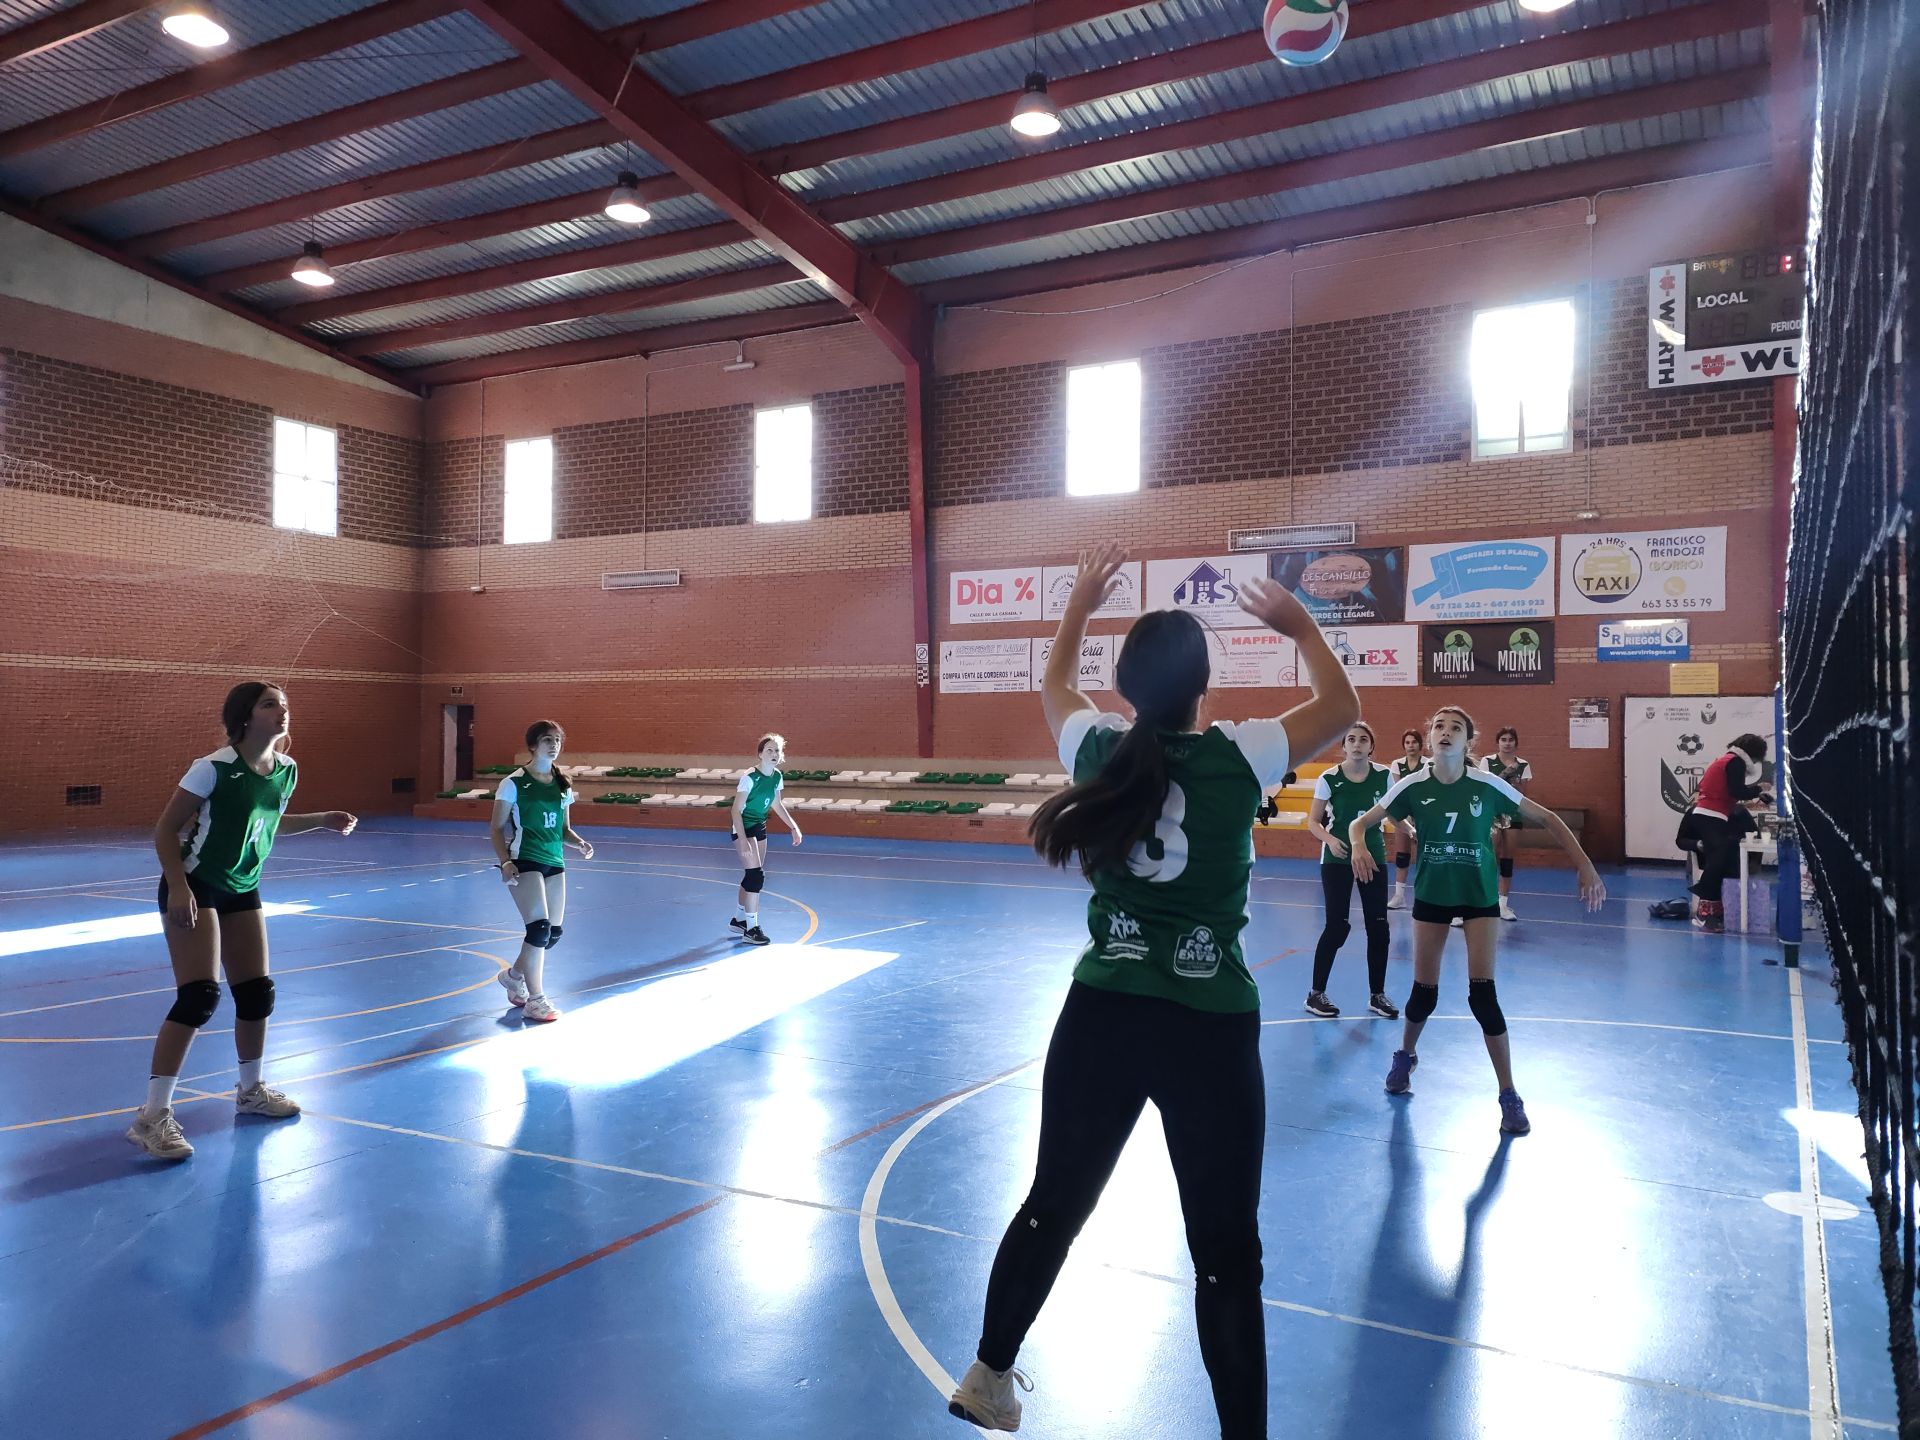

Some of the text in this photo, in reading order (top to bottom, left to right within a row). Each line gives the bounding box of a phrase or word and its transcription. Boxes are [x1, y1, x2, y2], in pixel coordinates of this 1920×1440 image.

[1696, 291, 1749, 309] LOCAL
[1658, 298, 1676, 385] WRTH
[1589, 536, 1628, 550] 24 HRS
[1646, 535, 1706, 547] FRANCISCO
[1650, 546, 1705, 557] MENDOZA
[1302, 571, 1371, 582] DESCANSILLO
[1583, 576, 1630, 592] TAXI
[957, 578, 1003, 606] Dia
[1014, 576, 1035, 602] %
[1641, 598, 1712, 609] 663 53 55 79
[1436, 611, 1482, 619] VALVERDE
[1601, 626, 1611, 638] S
[1231, 636, 1287, 646] MAPFRE
[1611, 634, 1621, 645] R
[1625, 635, 1661, 645] RIEGOS
[1342, 649, 1399, 666] BIEX
[1433, 646, 1475, 673] MONKI
[1498, 645, 1542, 672] MONKI
[942, 672, 961, 680] COMPRA
[976, 671, 983, 679] DE
[983, 671, 1009, 679] CORDEROS
[1013, 670, 1029, 678] LANAS
[764, 798, 771, 809] 9
[542, 811, 558, 829] 18
[1445, 812, 1459, 834] 7
[1185, 938, 1215, 952] Fed
